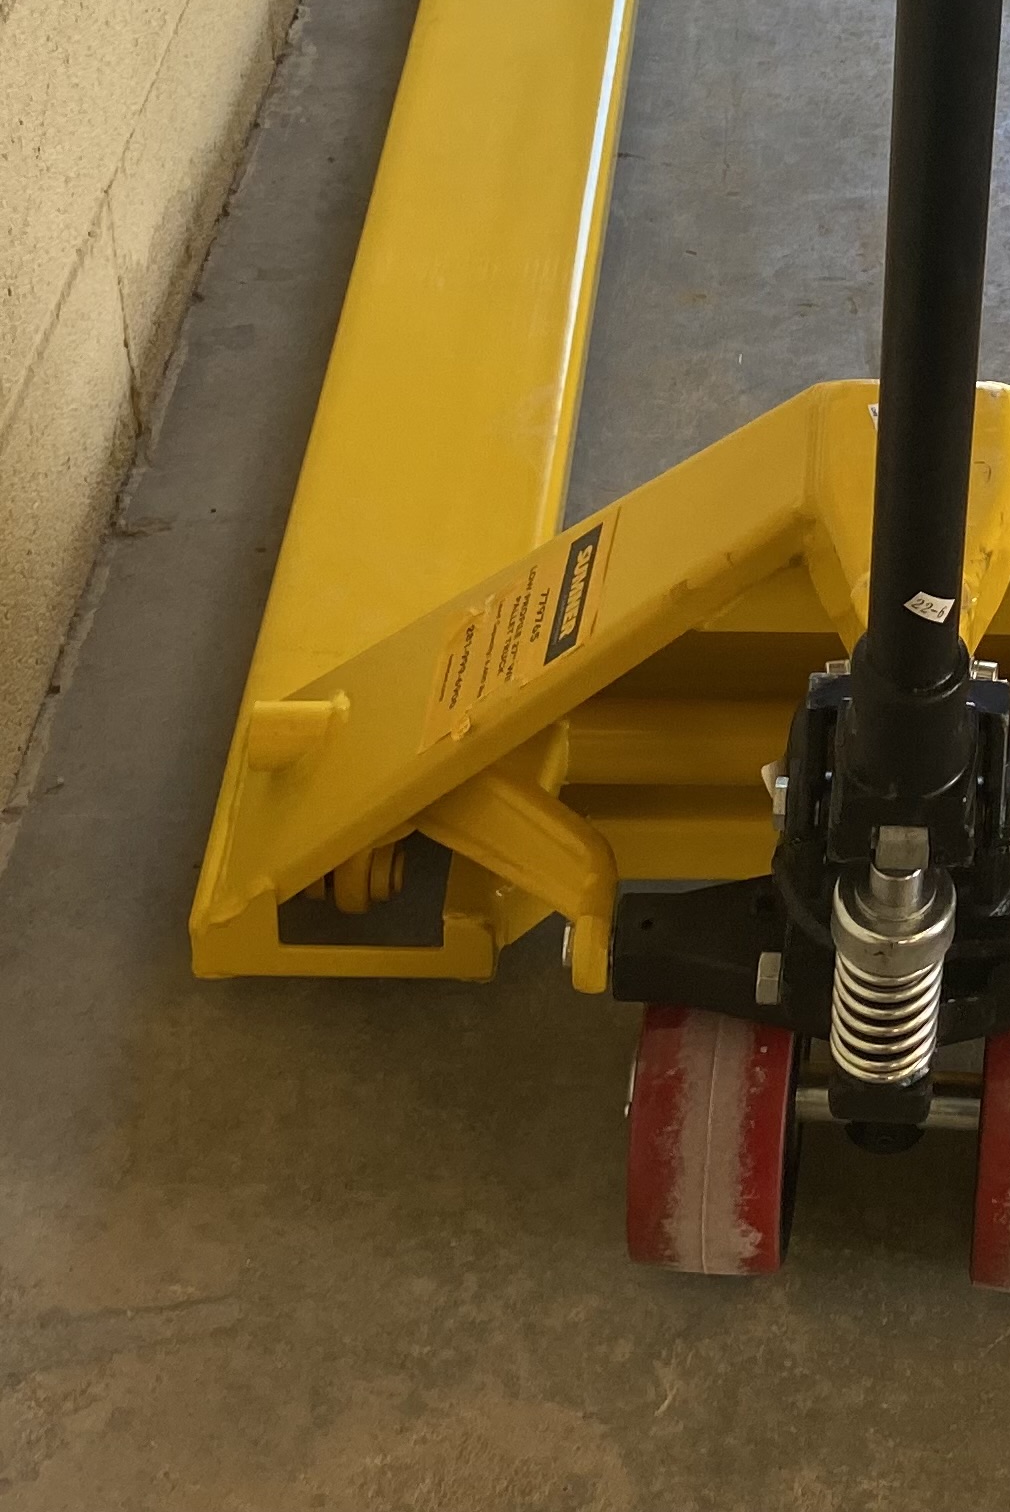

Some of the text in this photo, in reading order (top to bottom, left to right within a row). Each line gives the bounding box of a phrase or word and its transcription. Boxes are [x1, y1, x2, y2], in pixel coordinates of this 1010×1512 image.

[526, 565, 538, 590] LOW
[558, 544, 593, 641] SUMNER
[513, 593, 532, 641] PROFILE
[530, 588, 550, 642] 779765
[911, 598, 948, 618] 22-6
[497, 596, 522, 676] PALLET TRUCK
